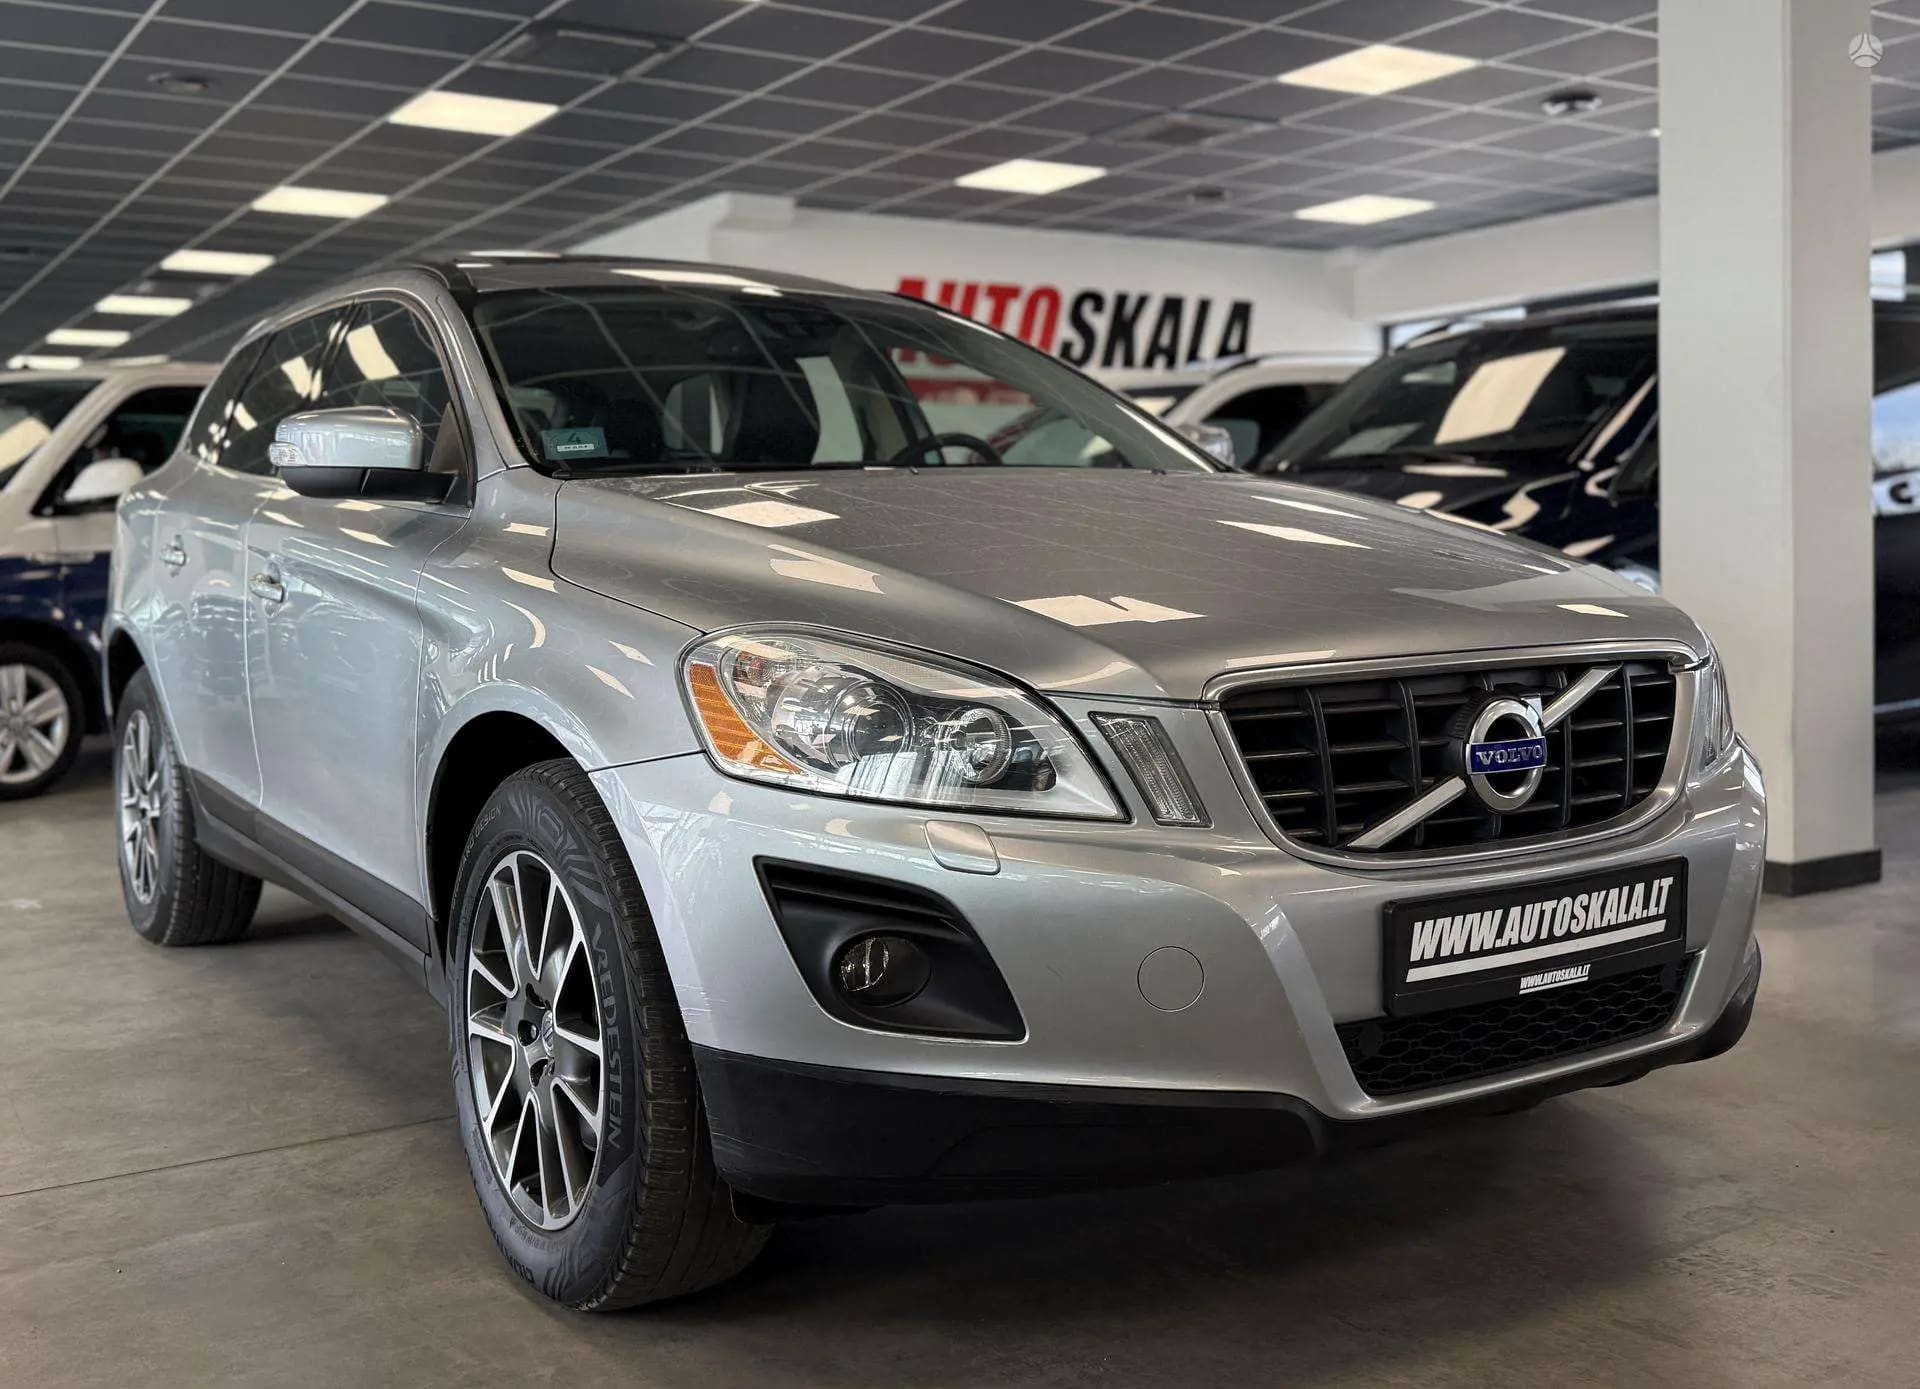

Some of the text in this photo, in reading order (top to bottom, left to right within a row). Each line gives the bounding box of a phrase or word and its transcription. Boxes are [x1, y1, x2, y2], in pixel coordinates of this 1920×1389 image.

[1475, 745, 1543, 766] VOLVO
[1409, 877, 1674, 962] WWW.AUTOSKALA.LT
[1519, 964, 1592, 990] WWW.AUTOSKALA.LT
[591, 922, 624, 1150] VREDESTEIN
